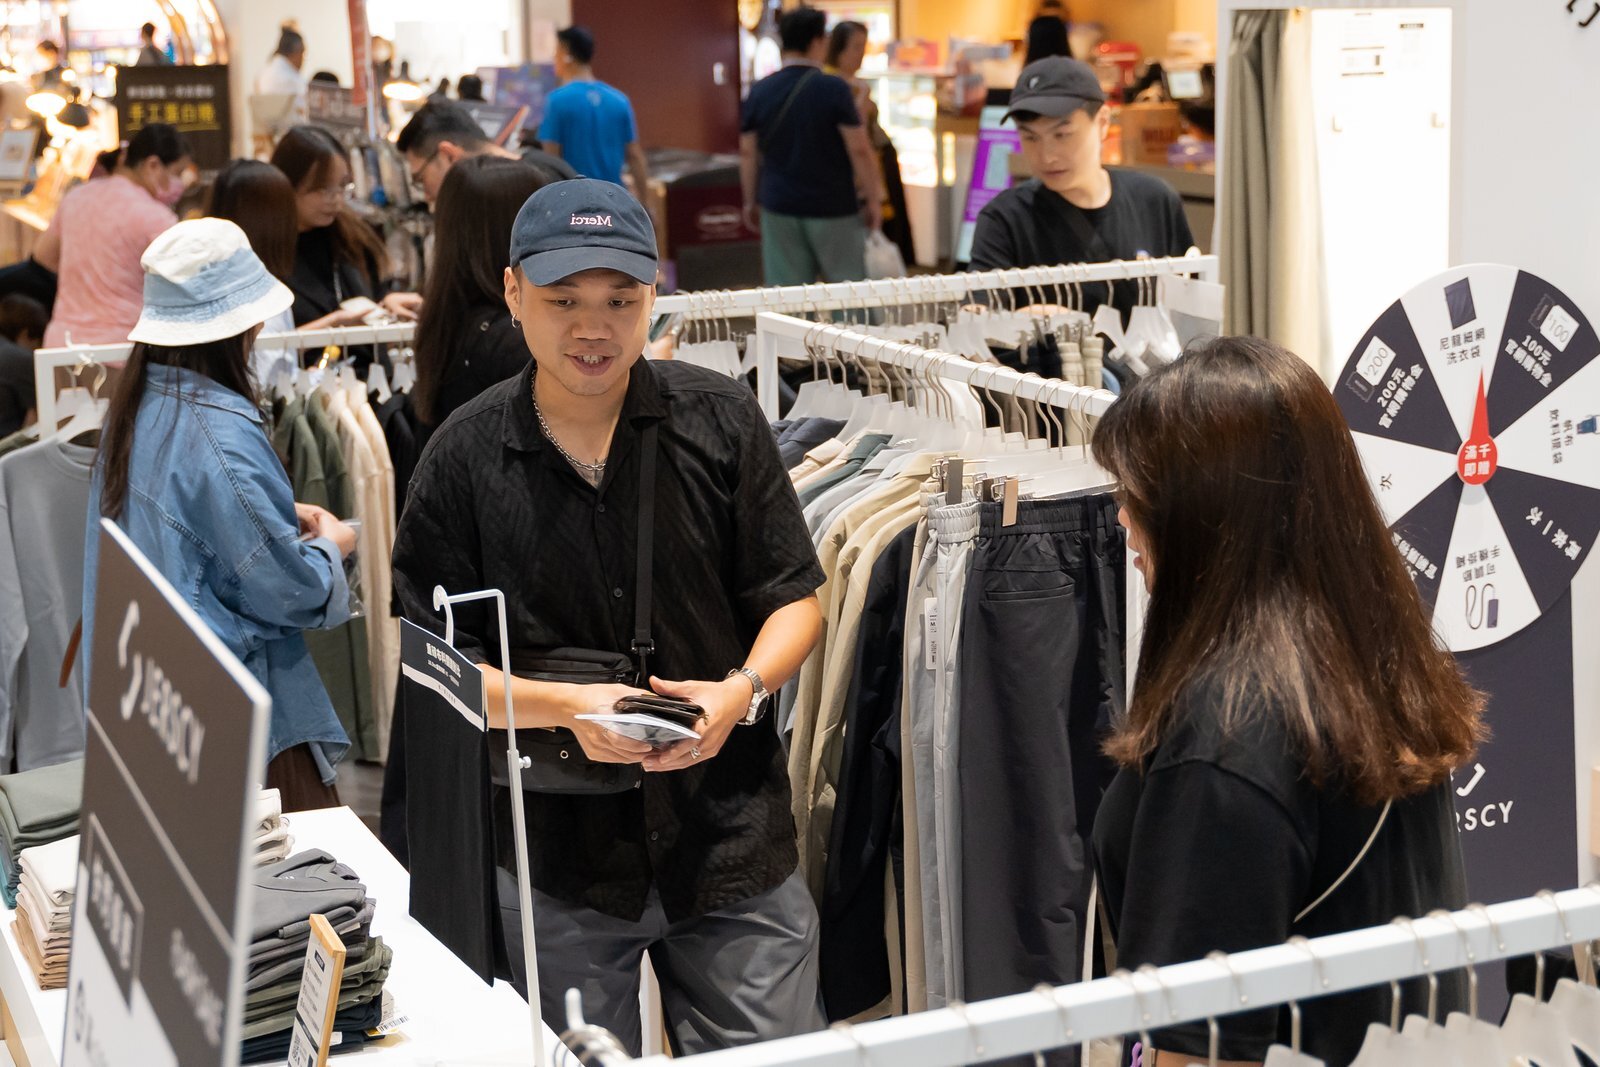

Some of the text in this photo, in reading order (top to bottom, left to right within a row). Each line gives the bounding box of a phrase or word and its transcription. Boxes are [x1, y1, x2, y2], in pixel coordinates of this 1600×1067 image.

[1446, 345, 1481, 365] 洗衣袋
[1522, 335, 1553, 366] 100元
[1376, 367, 1406, 408] 200元
